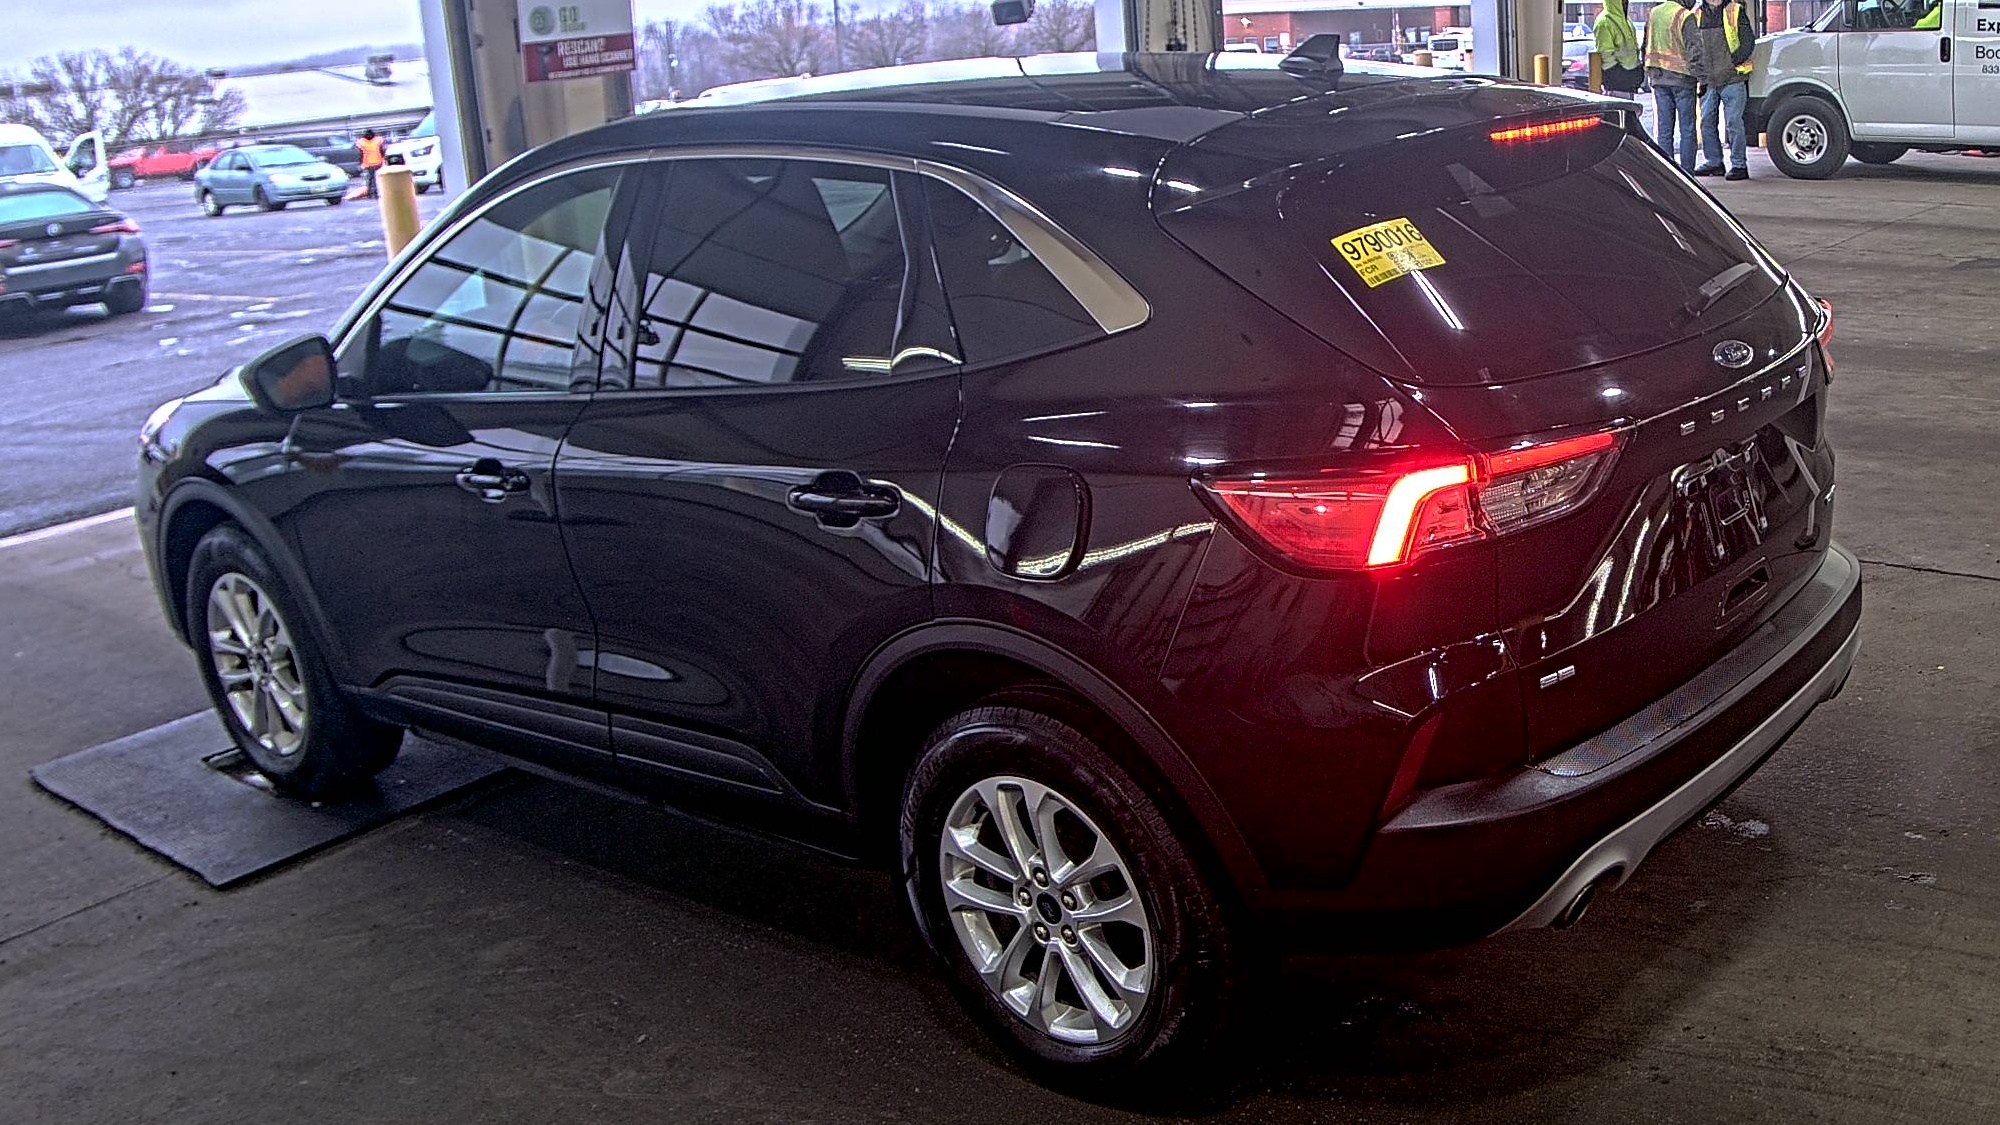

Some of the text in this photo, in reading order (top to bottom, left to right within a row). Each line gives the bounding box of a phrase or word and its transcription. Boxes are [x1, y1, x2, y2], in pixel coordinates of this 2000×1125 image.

[1982, 64, 1999, 74] 833
[1341, 223, 1422, 260] 9790016
[1680, 365, 1807, 436] ESCAPE
